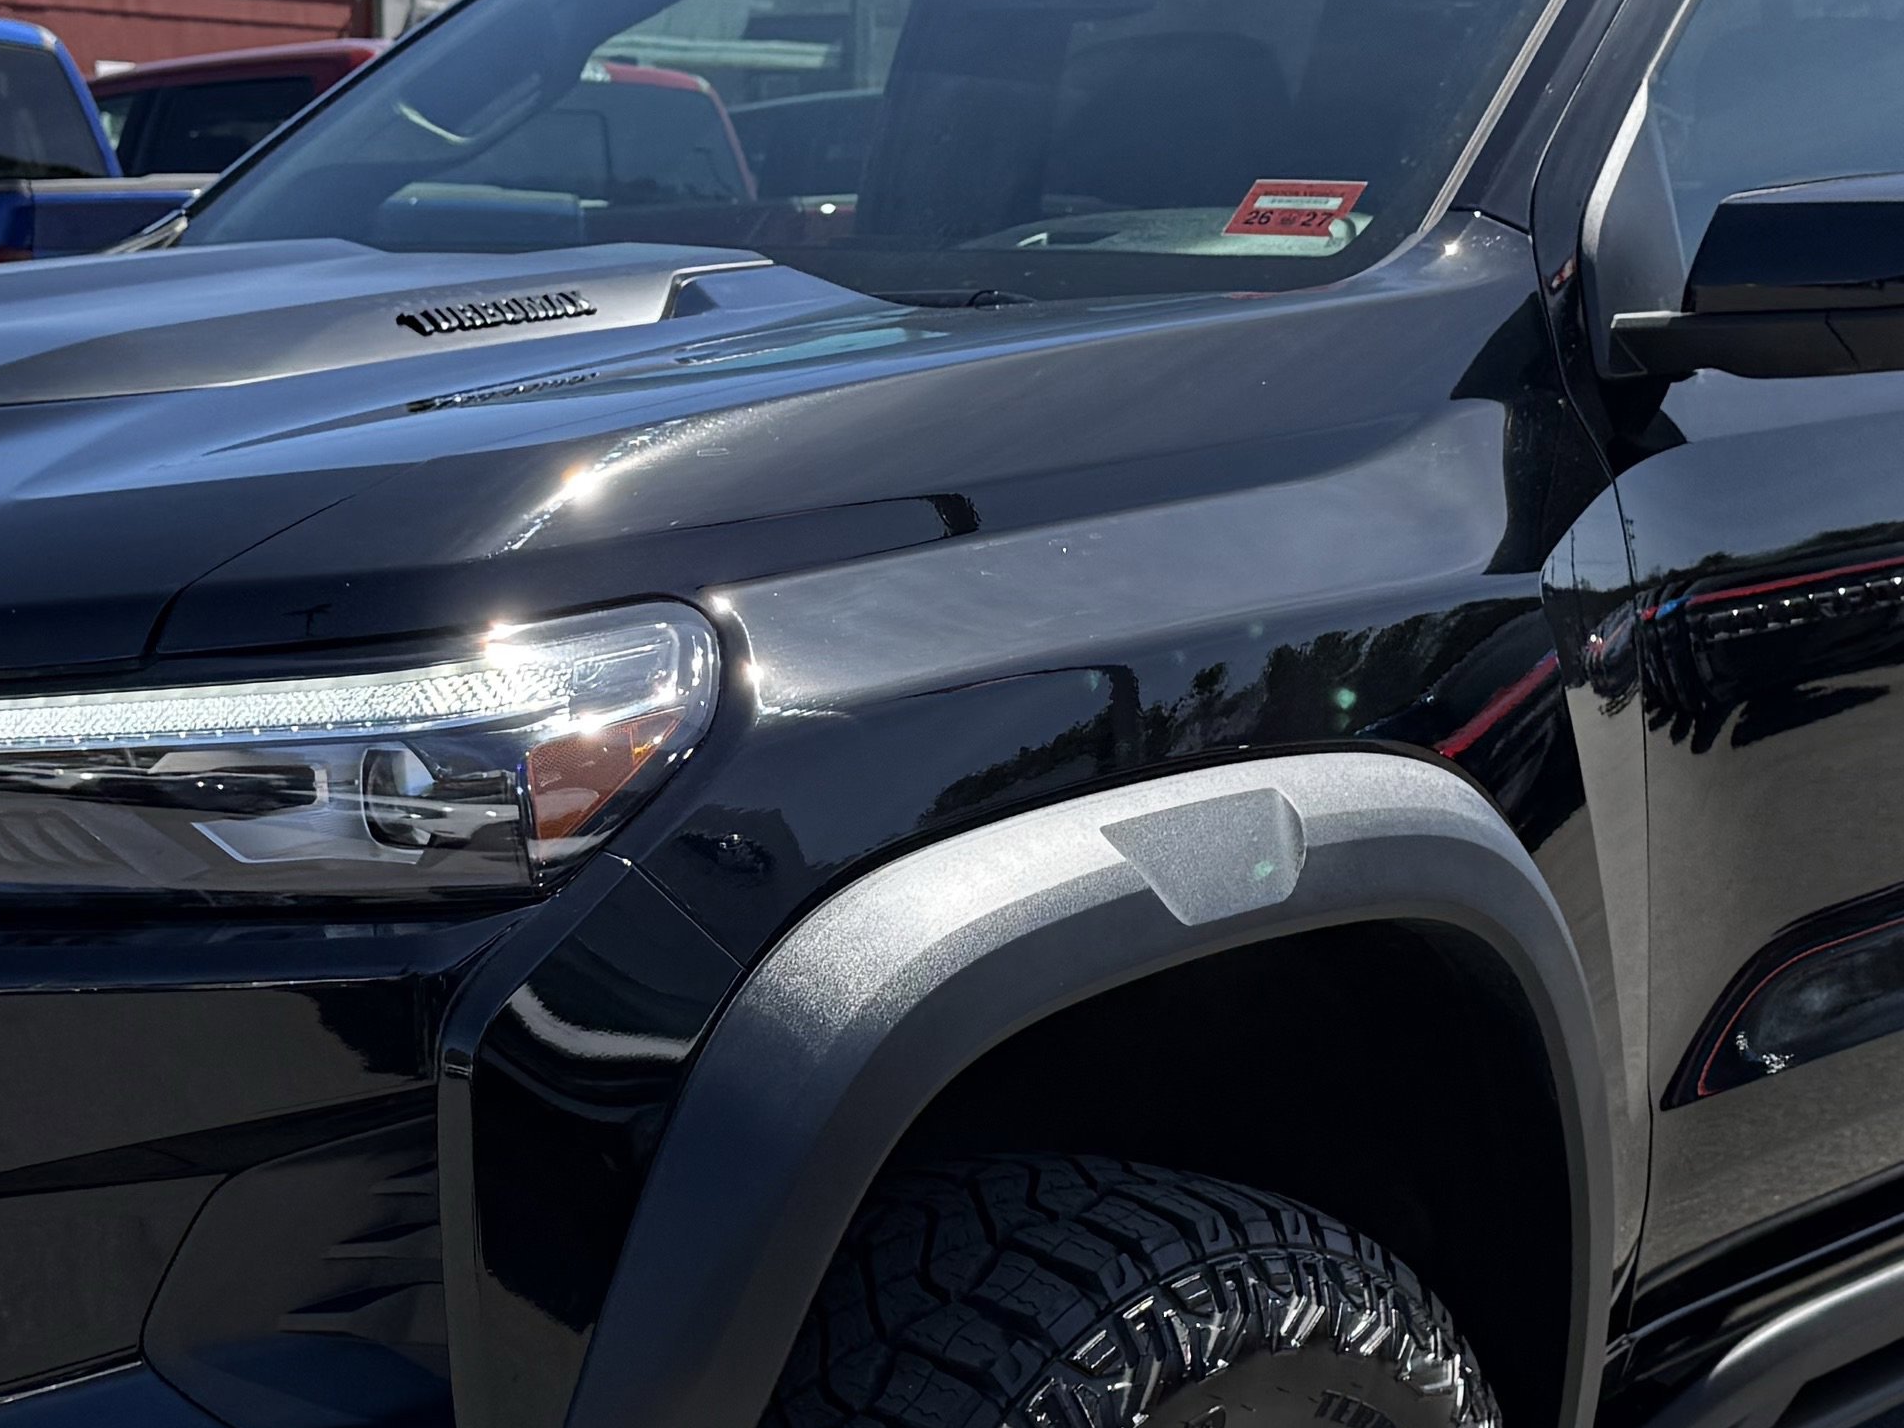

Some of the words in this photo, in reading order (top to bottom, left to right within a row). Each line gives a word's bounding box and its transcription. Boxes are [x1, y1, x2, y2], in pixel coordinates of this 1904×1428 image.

[1243, 210, 1274, 226] 26
[1300, 211, 1334, 227] 27
[396, 290, 596, 337] TURBOMAX
